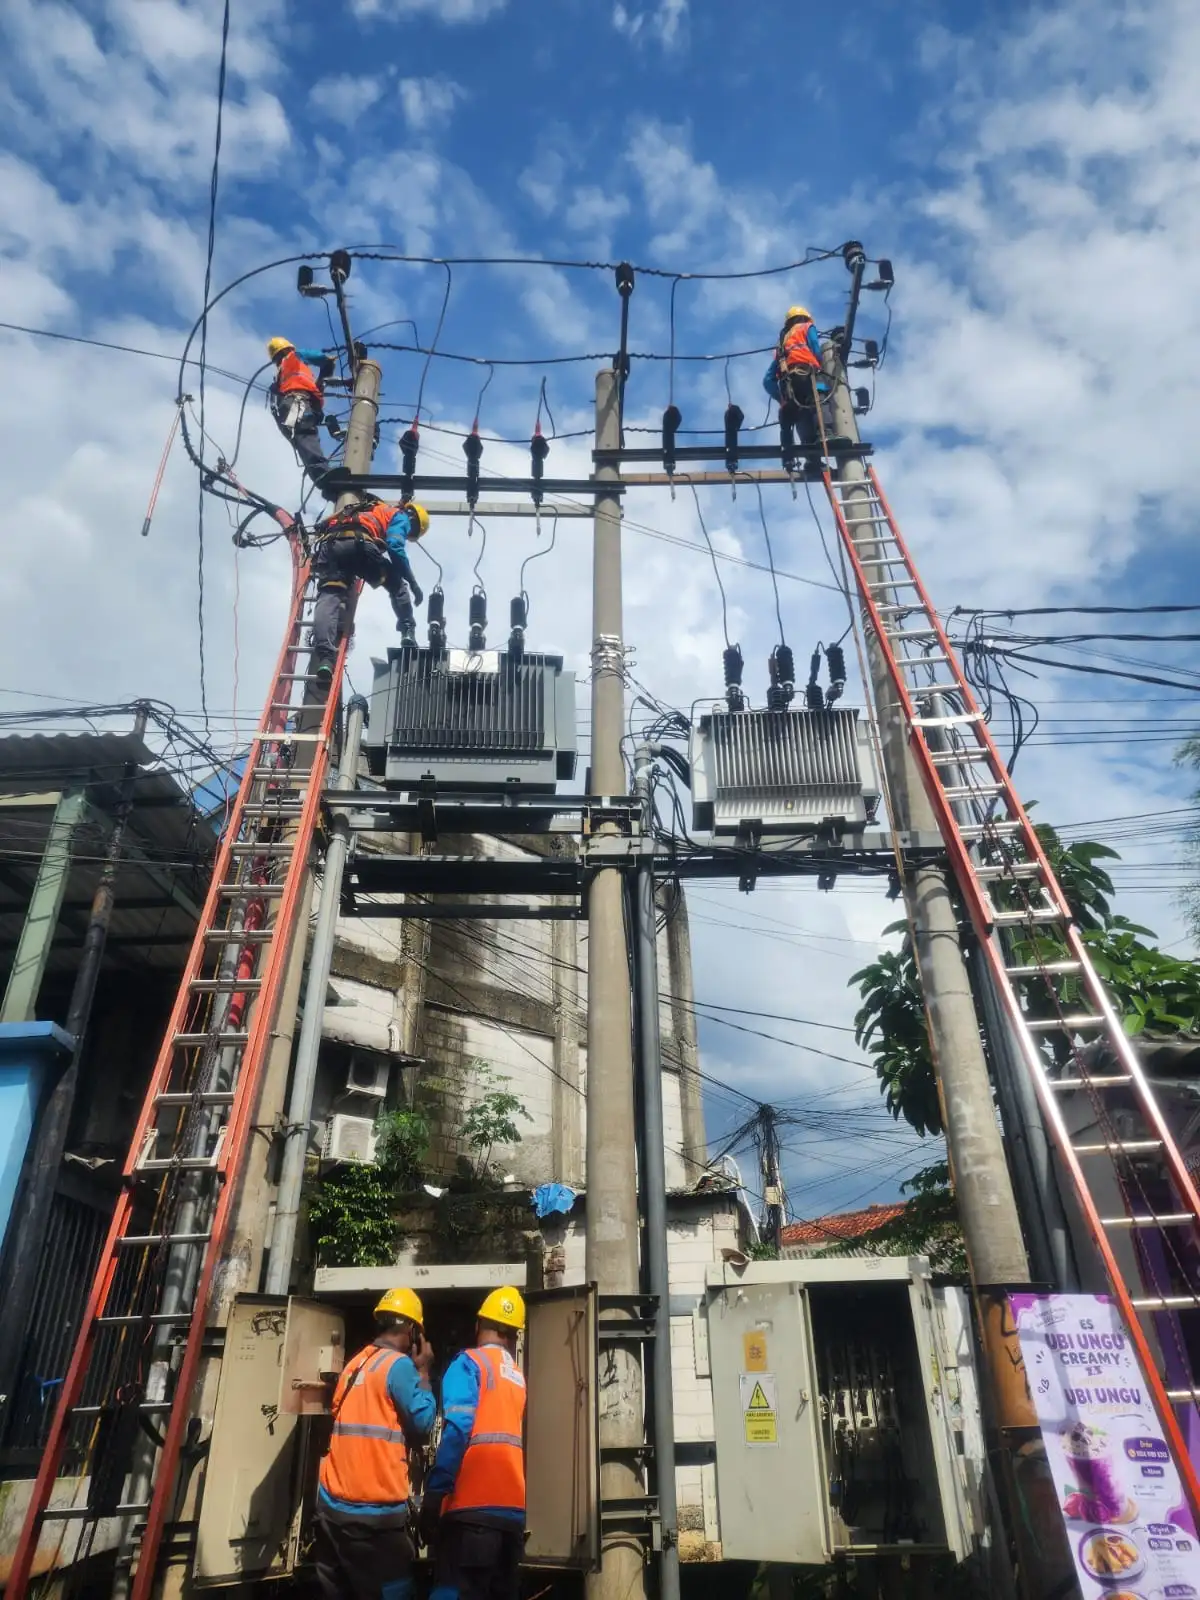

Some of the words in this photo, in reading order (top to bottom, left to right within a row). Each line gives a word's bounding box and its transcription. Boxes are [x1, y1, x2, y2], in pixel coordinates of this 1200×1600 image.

[1079, 1319, 1095, 1330] ES
[1044, 1333, 1075, 1350] UBI
[1077, 1333, 1125, 1350] UNGU
[1060, 1352, 1120, 1366] CREAMY
[1064, 1388, 1093, 1406] UBI
[1094, 1388, 1142, 1405] UNGU
